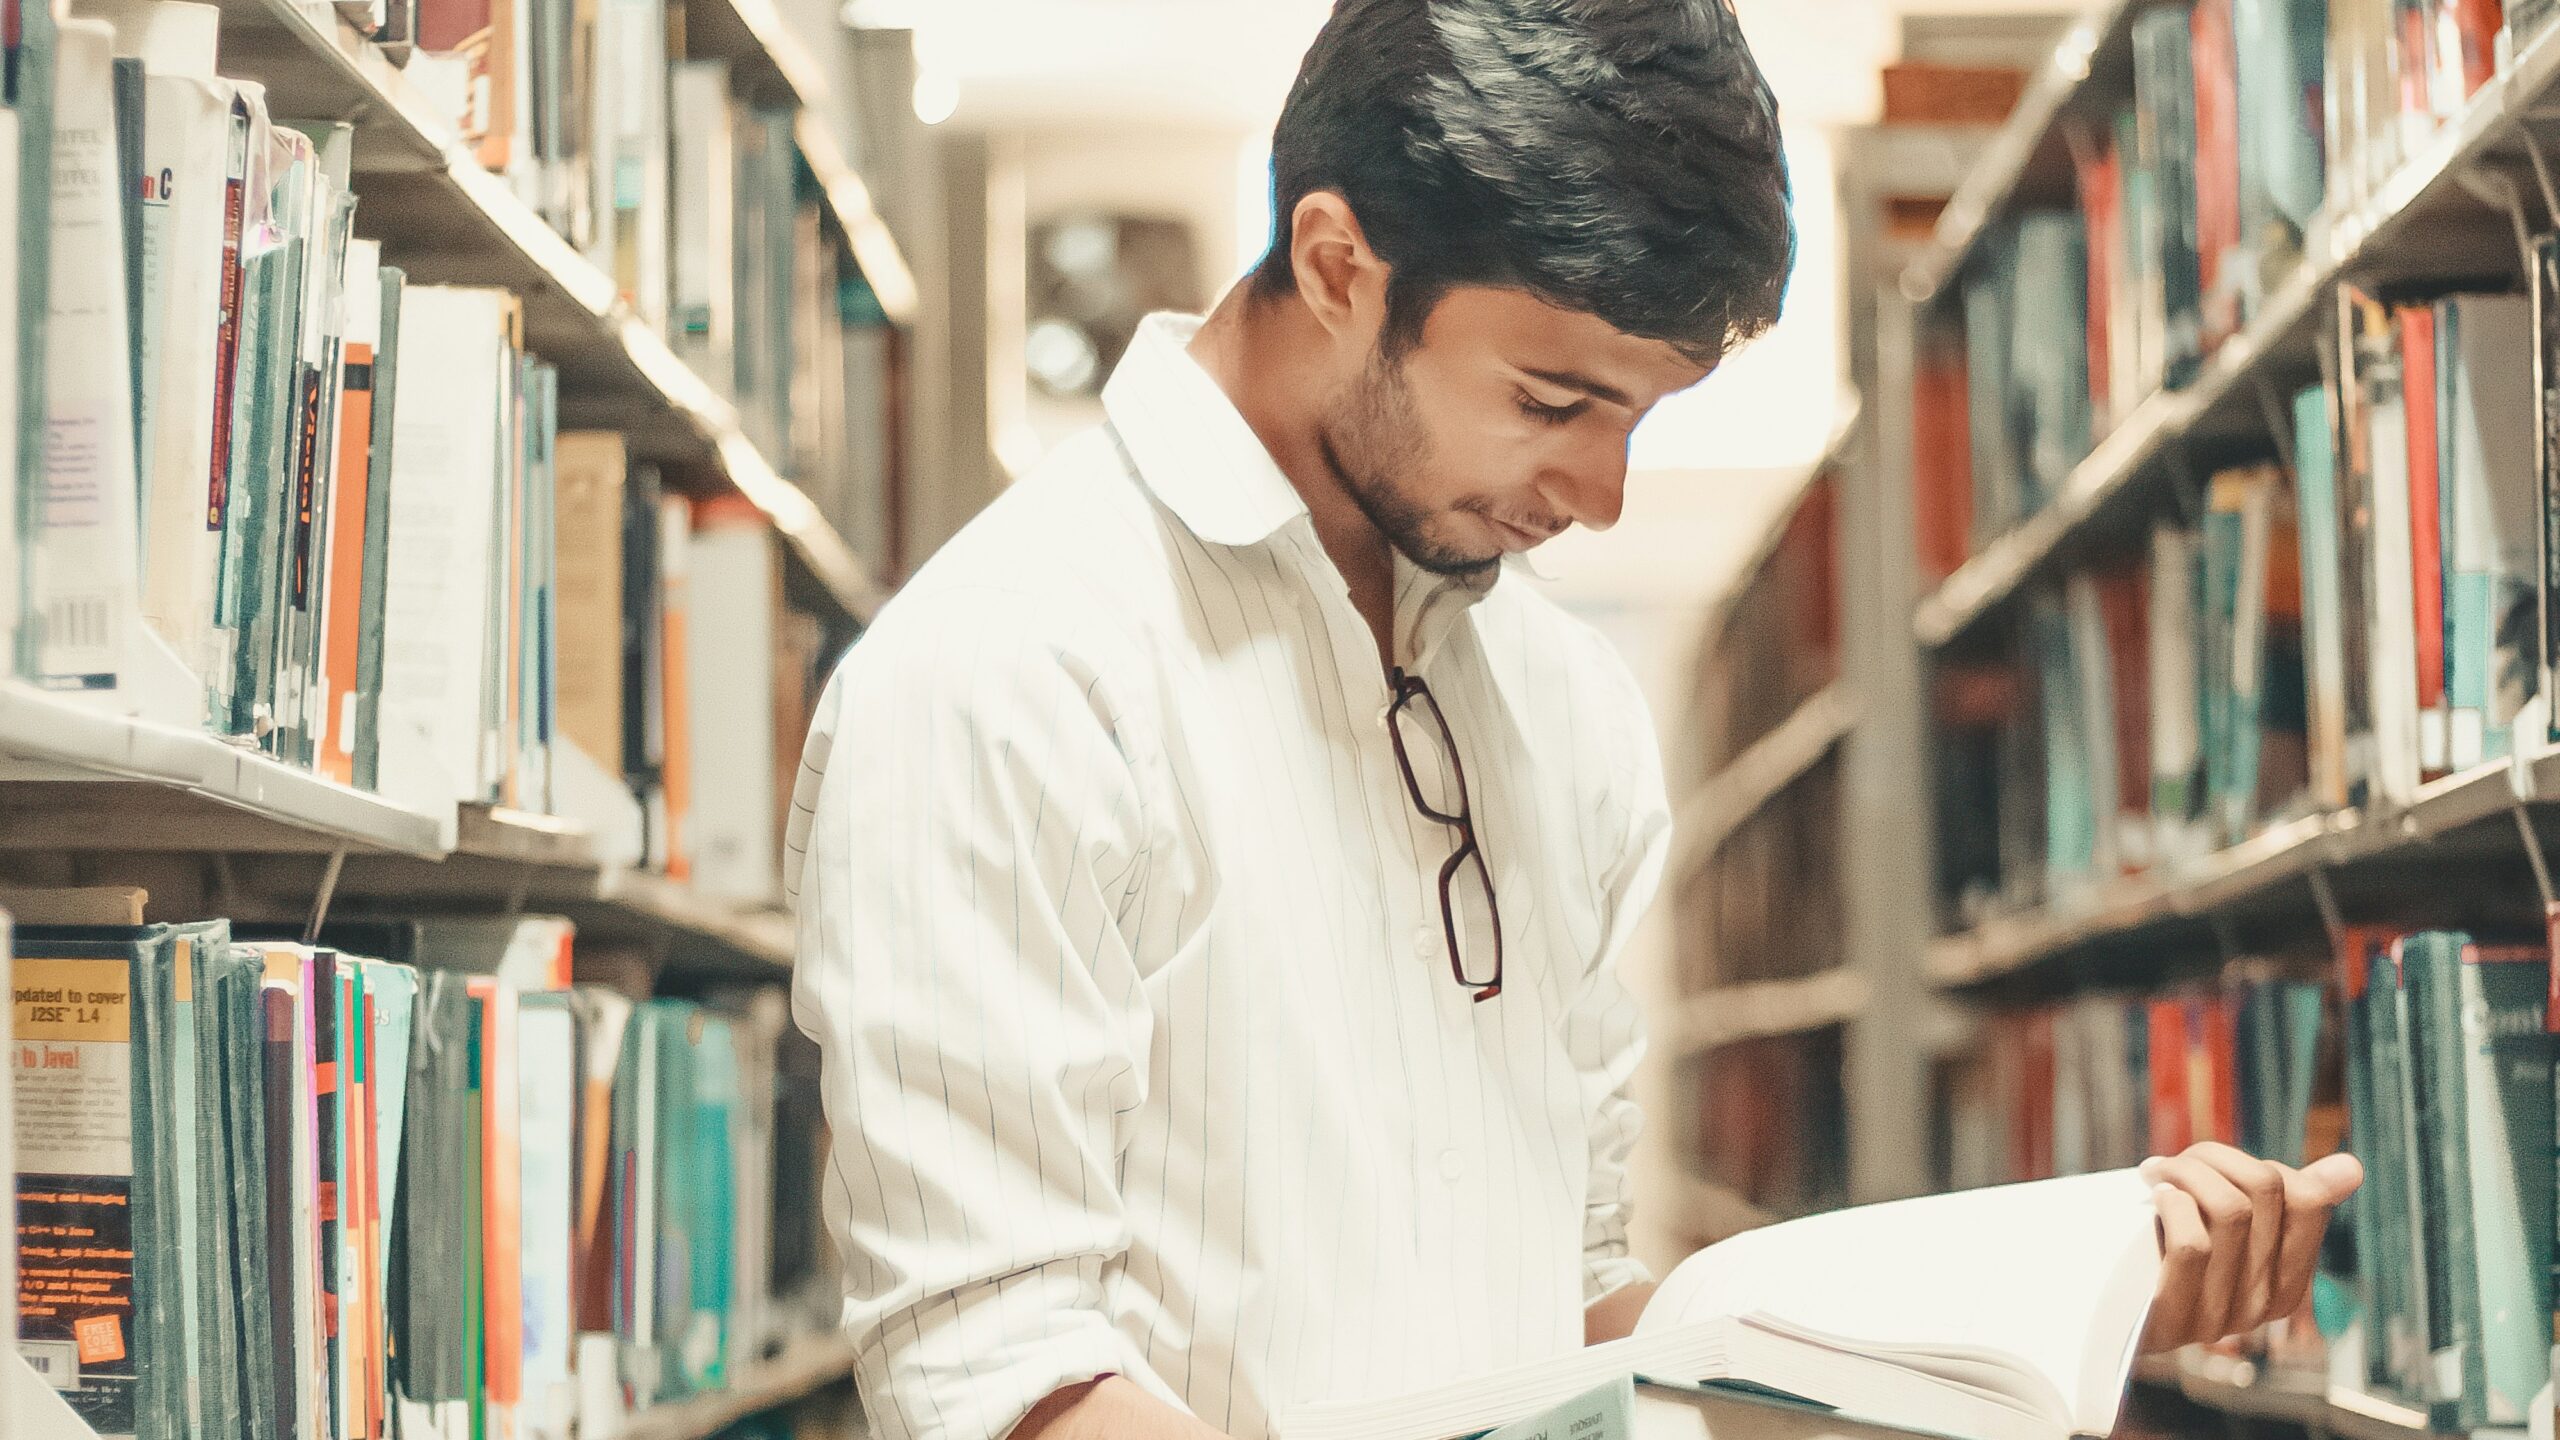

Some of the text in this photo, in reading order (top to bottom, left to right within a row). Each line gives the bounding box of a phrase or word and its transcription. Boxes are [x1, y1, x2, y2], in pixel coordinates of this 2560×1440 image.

[160, 167, 173, 200] C
[13, 987, 127, 1006] pdated to cover
[77, 1006, 100, 1024] 1.4
